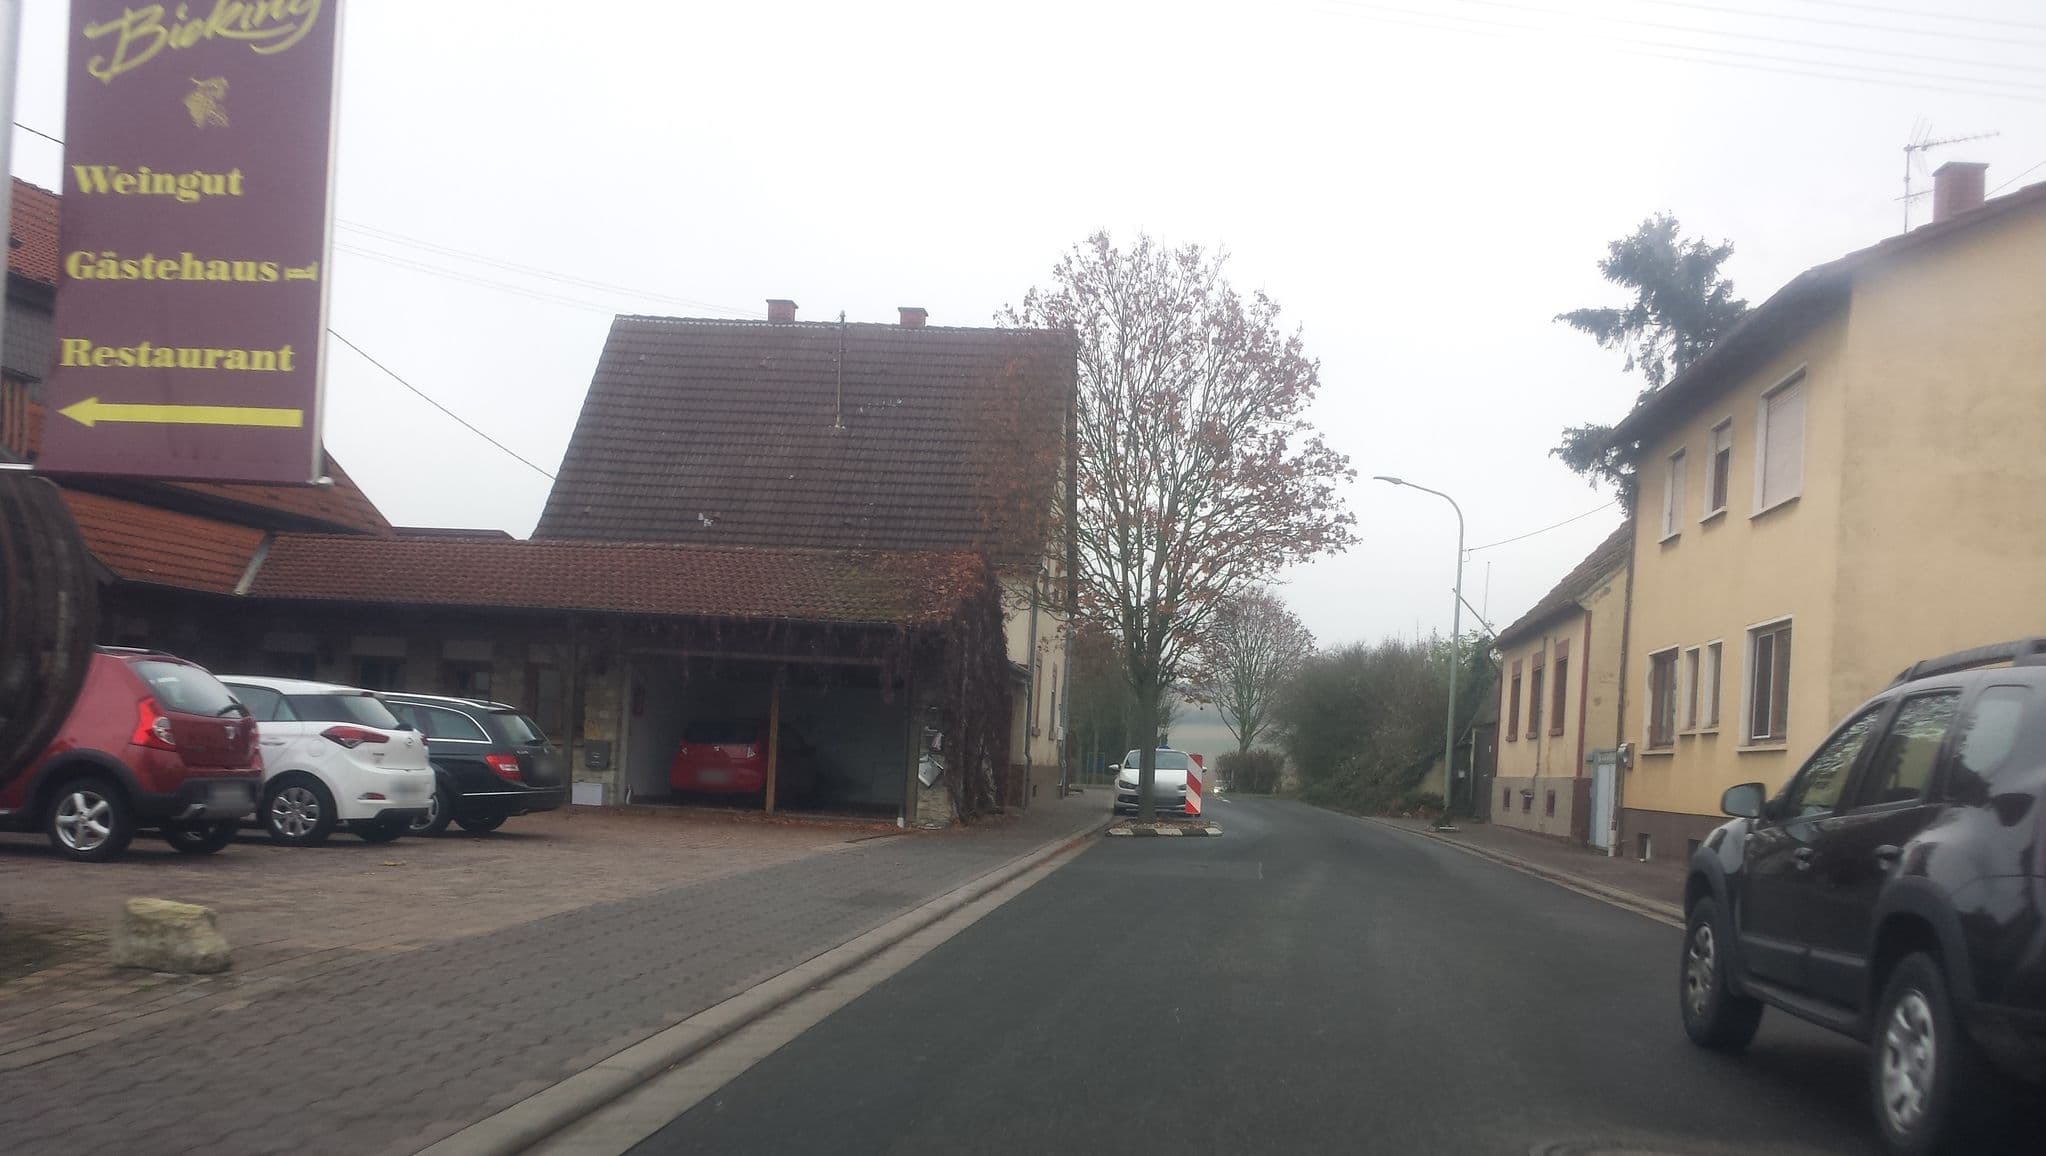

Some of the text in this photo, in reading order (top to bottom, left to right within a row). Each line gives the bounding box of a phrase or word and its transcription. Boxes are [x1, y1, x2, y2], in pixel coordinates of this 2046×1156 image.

[72, 164, 244, 203] Weingut
[65, 250, 280, 282] Gästehaus
[59, 338, 296, 372] Restaurant
